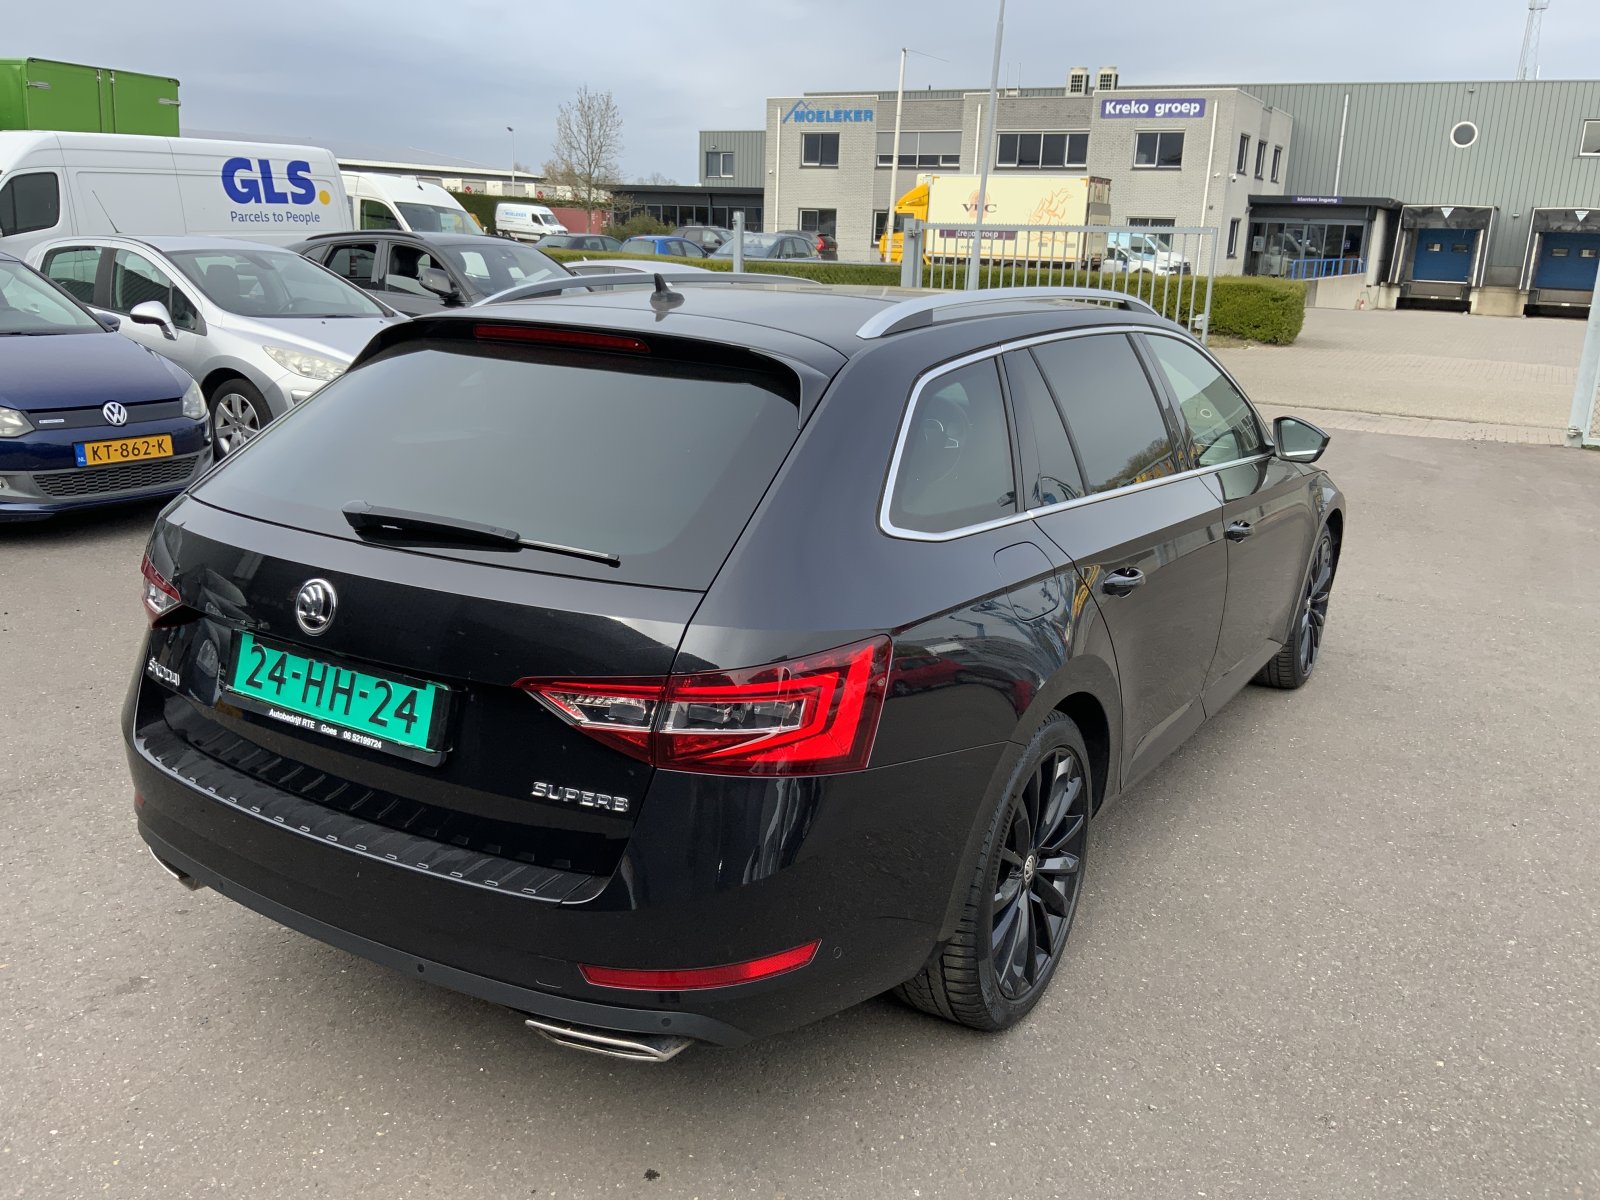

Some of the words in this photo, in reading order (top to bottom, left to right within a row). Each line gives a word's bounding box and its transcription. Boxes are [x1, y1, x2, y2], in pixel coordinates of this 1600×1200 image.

[794, 109, 873, 123] MOELEKER
[1105, 100, 1149, 114] Kreko
[1155, 102, 1200, 117] groep
[230, 210, 270, 223] Parcels
[273, 212, 284, 223] to
[286, 211, 321, 226] People
[91, 439, 167, 461] KT-862-K
[245, 643, 419, 734] 24-HH-24
[268, 708, 303, 726] Autobedrijf
[302, 718, 316, 729] RTE
[320, 724, 338, 736] Goes
[343, 730, 352, 740] 06
[530, 781, 629, 812] SUPERB
